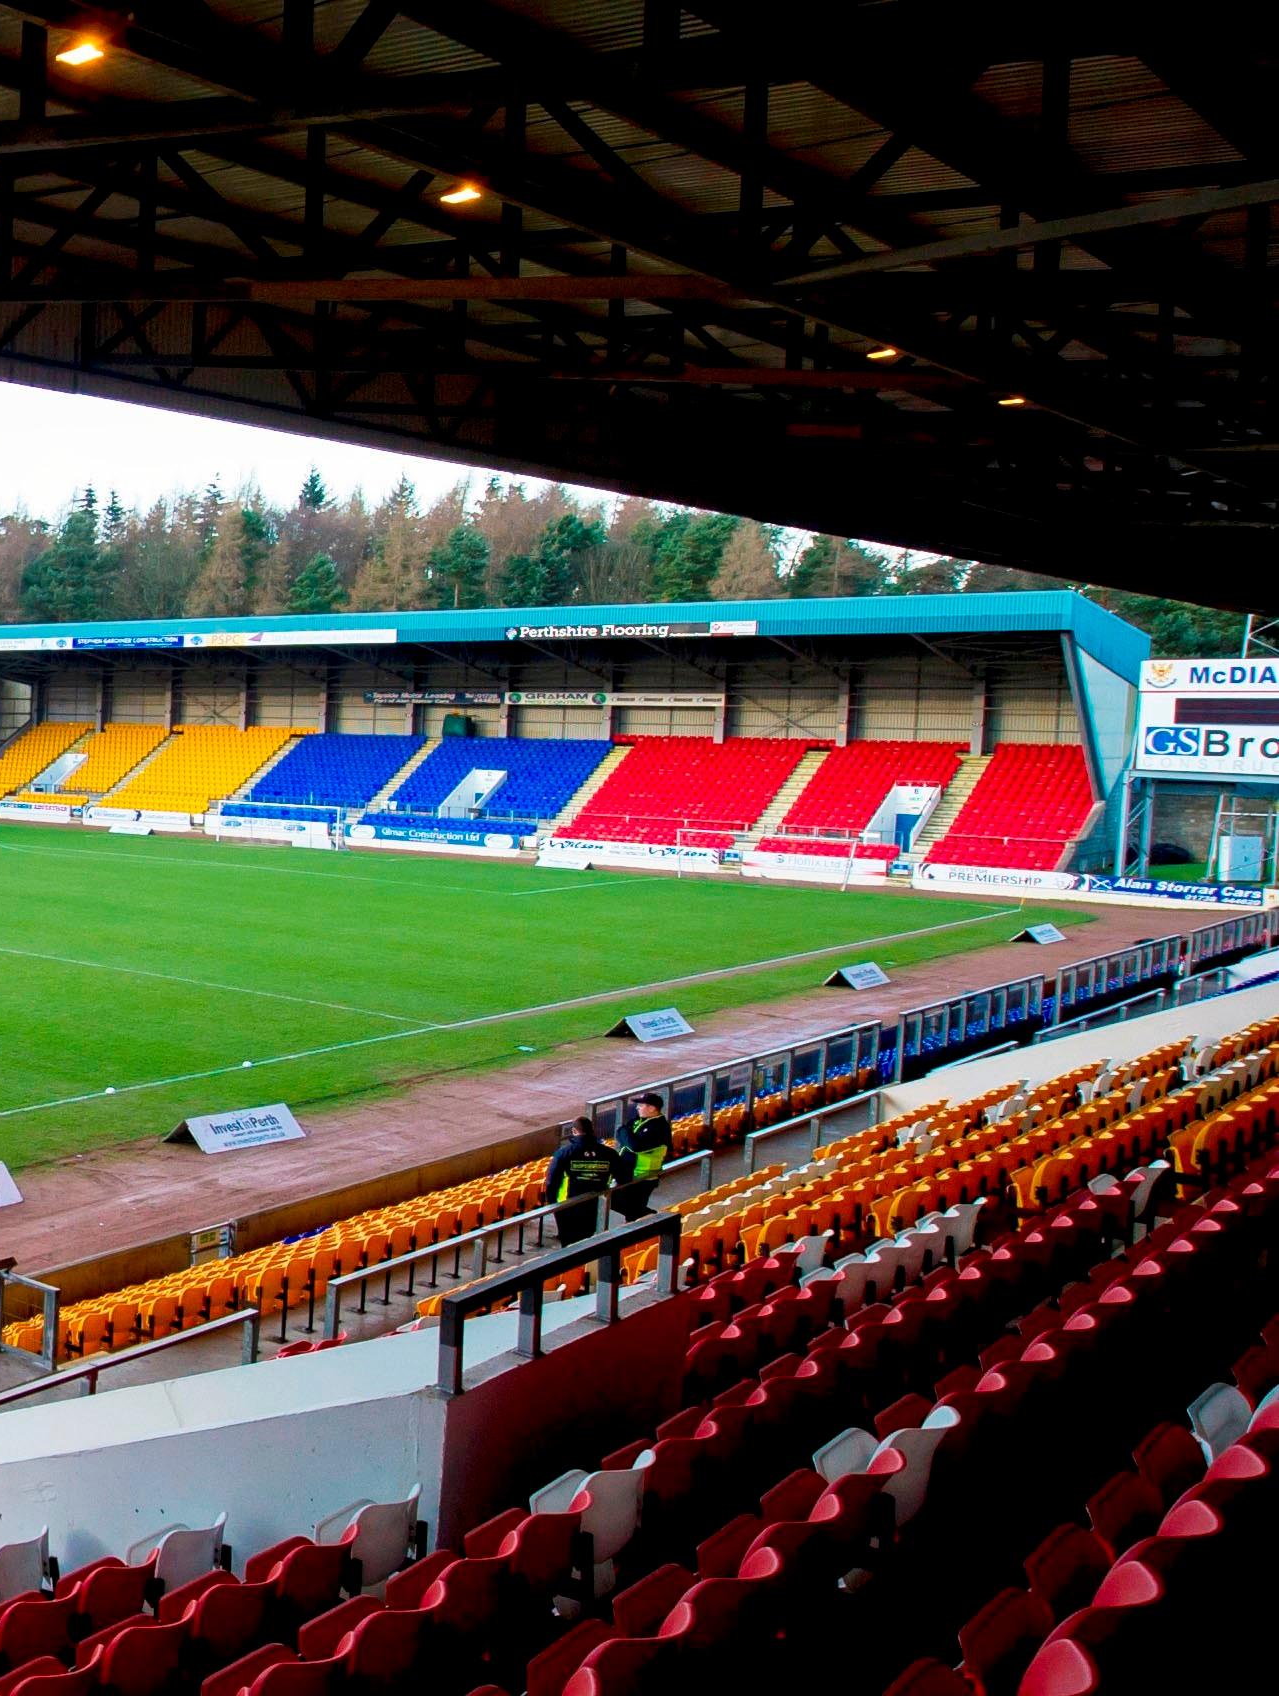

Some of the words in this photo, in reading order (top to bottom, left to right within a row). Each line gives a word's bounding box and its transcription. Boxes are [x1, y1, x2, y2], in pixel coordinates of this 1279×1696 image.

[519, 625, 597, 637] Perthshire
[600, 623, 669, 637] Flooring
[211, 634, 240, 645] PSPC
[1189, 666, 1277, 684] McDIA
[425, 692, 456, 700] Leasing
[408, 828, 464, 841] Construction
[465, 831, 480, 841] Ltd
[549, 840, 604, 850] Wilson
[648, 846, 708, 858] Wilson
[948, 871, 1042, 886] PREMIERSHIP
[1114, 877, 1152, 889] Alan
[1155, 880, 1218, 895] Storrar
[1220, 886, 1262, 899] Cars
[209, 1119, 244, 1135] Invest
[251, 1113, 280, 1128] Perth
